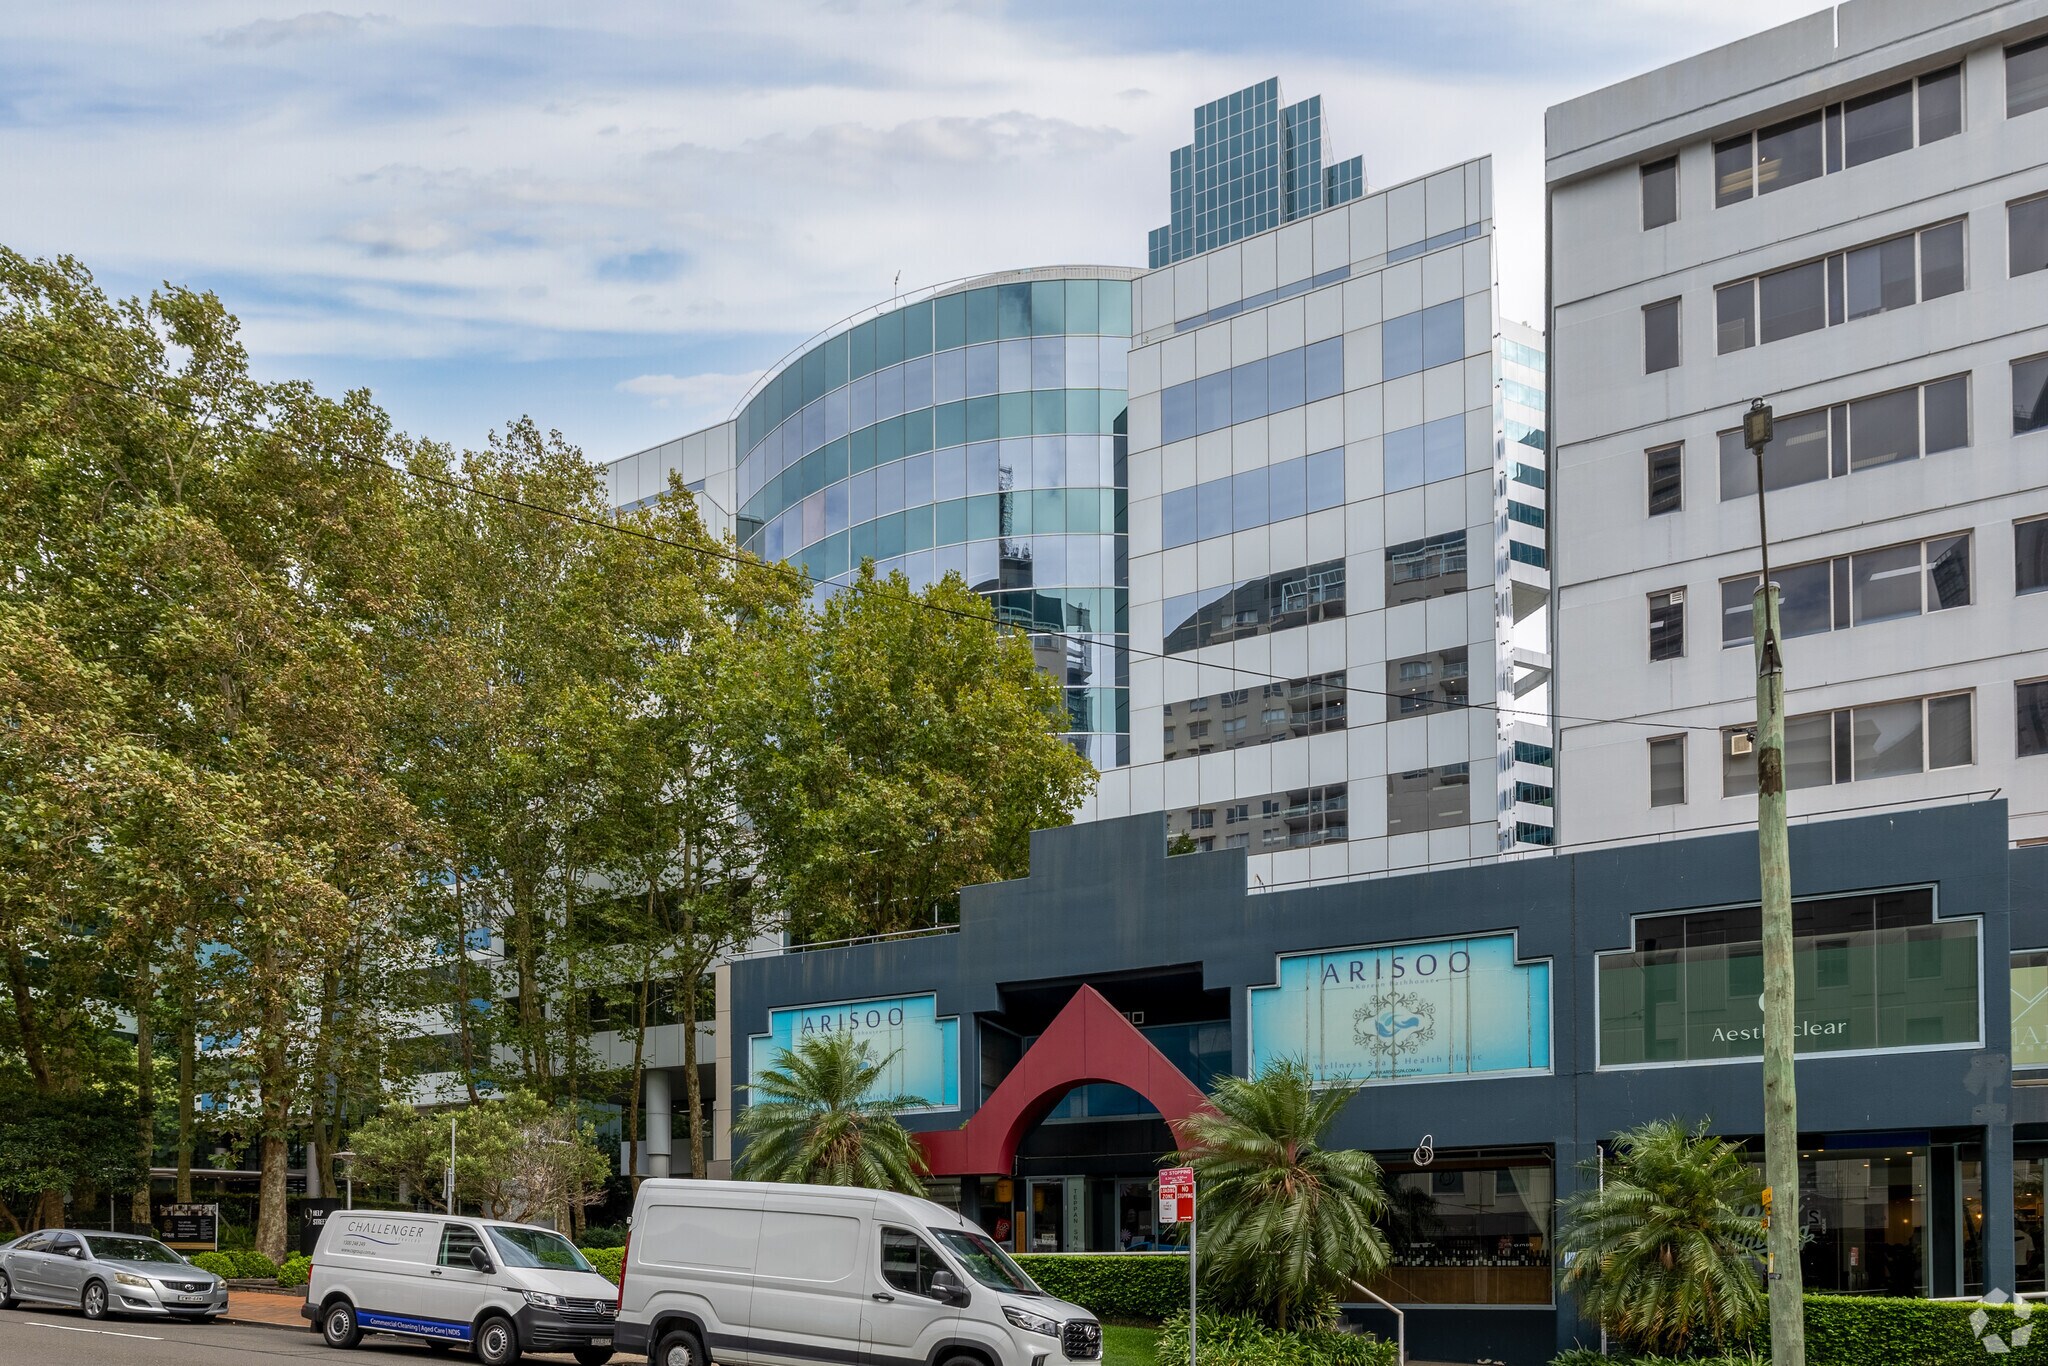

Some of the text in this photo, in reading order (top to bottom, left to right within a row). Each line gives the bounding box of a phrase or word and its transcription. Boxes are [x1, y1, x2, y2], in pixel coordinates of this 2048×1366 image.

[1322, 951, 1471, 985] ARISOO
[802, 1007, 903, 1034] ARISOO
[1404, 1055, 1442, 1065] Health
[1447, 1053, 1483, 1063] liic
[304, 1207, 312, 1227] 9
[348, 1221, 424, 1237] CHALLENGER
[370, 1317, 461, 1336] Commercial Cleaning Aged Care NDIS
